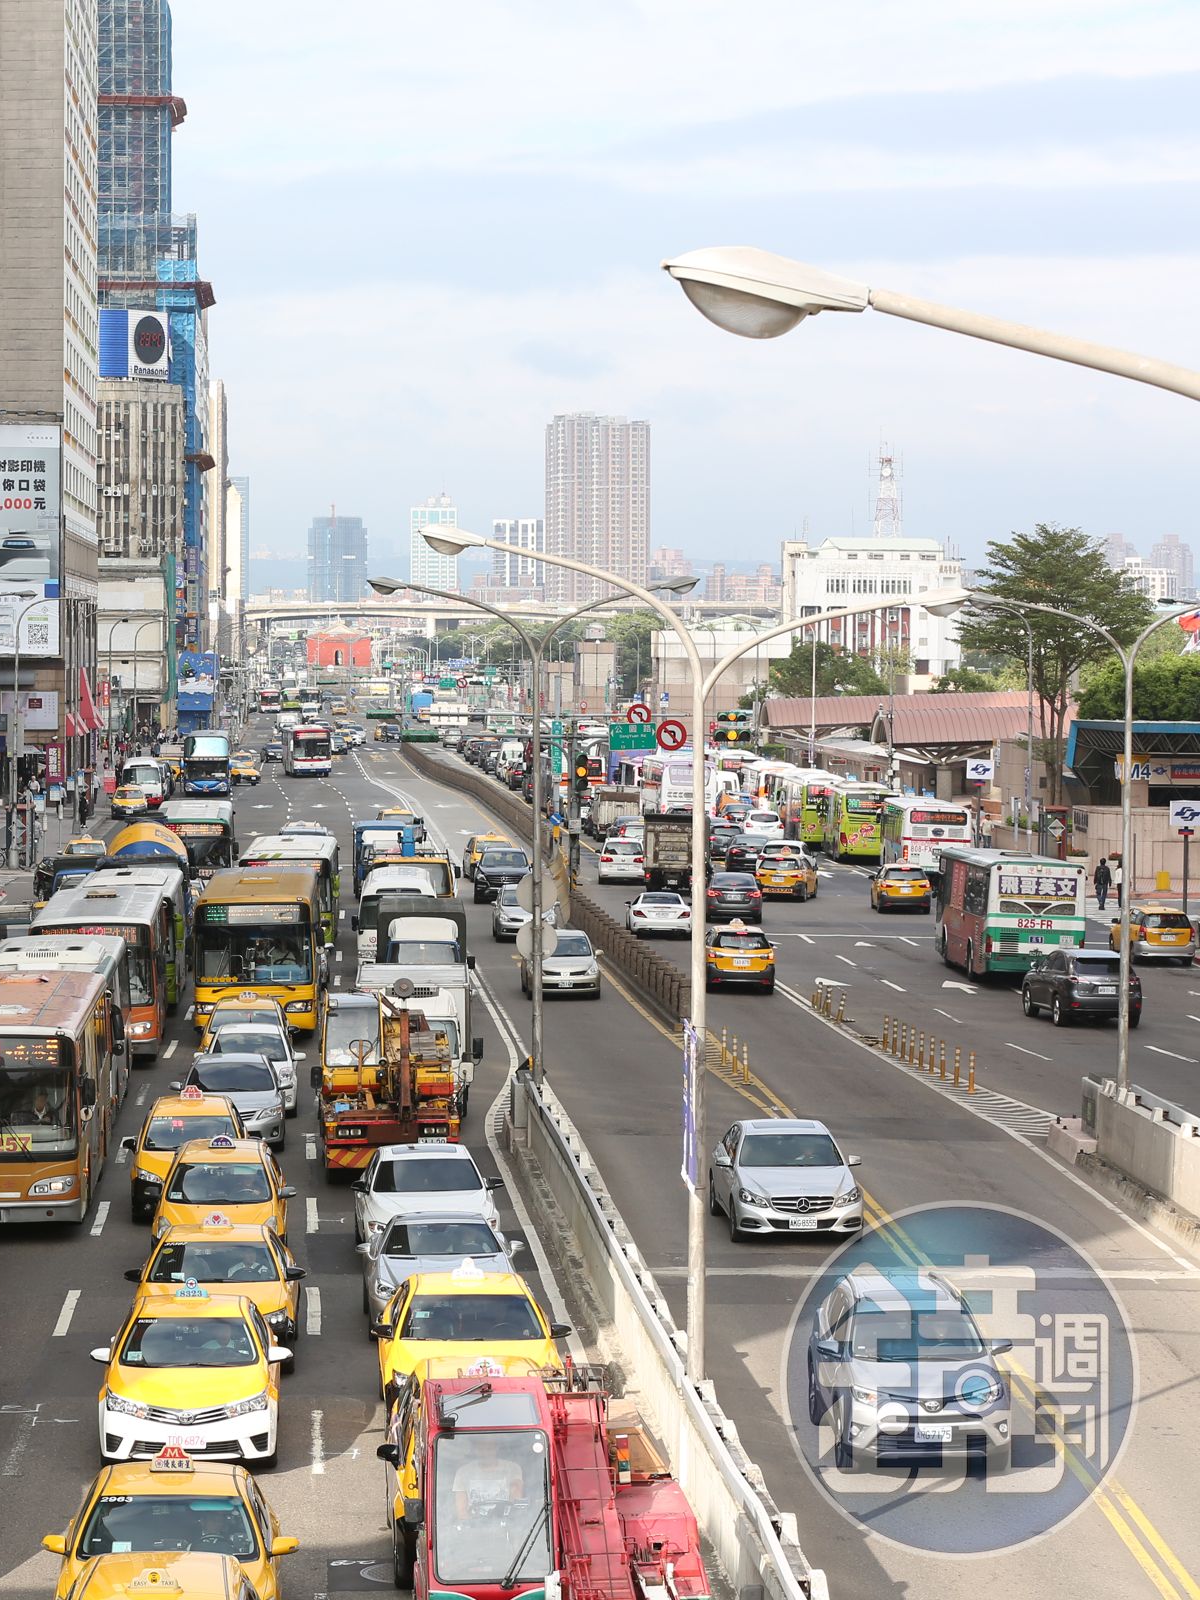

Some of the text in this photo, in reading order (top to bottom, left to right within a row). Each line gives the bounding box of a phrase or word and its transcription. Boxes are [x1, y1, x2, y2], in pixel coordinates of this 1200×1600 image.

[133, 365, 169, 377] Panasonic
[614, 725, 652, 734] 公園路
[1000, 876, 1076, 897] 飛哥英文
[1017, 918, 1053, 929] 825-FR
[163, 1459, 191, 1469] 優良衛星
